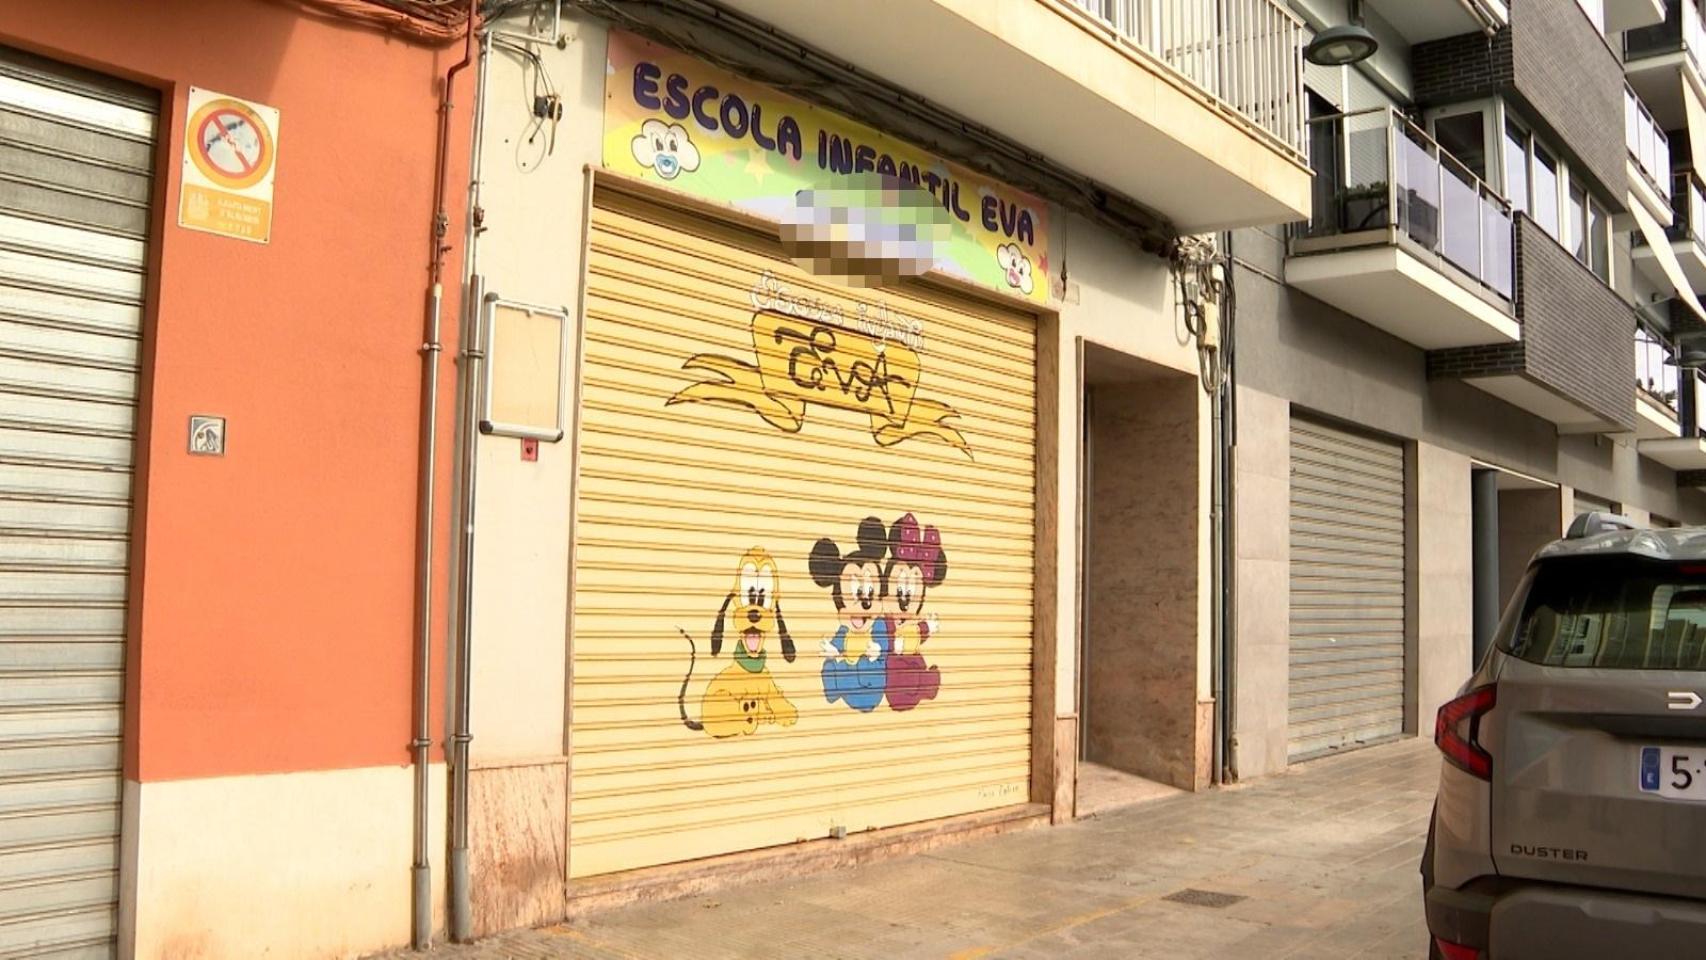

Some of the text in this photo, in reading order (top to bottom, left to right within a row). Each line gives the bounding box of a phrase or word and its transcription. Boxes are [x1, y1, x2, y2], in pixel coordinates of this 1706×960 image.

[633, 61, 802, 161] ESCOLA
[982, 195, 1034, 247] EVA
[1510, 844, 1588, 861] DUSTER
